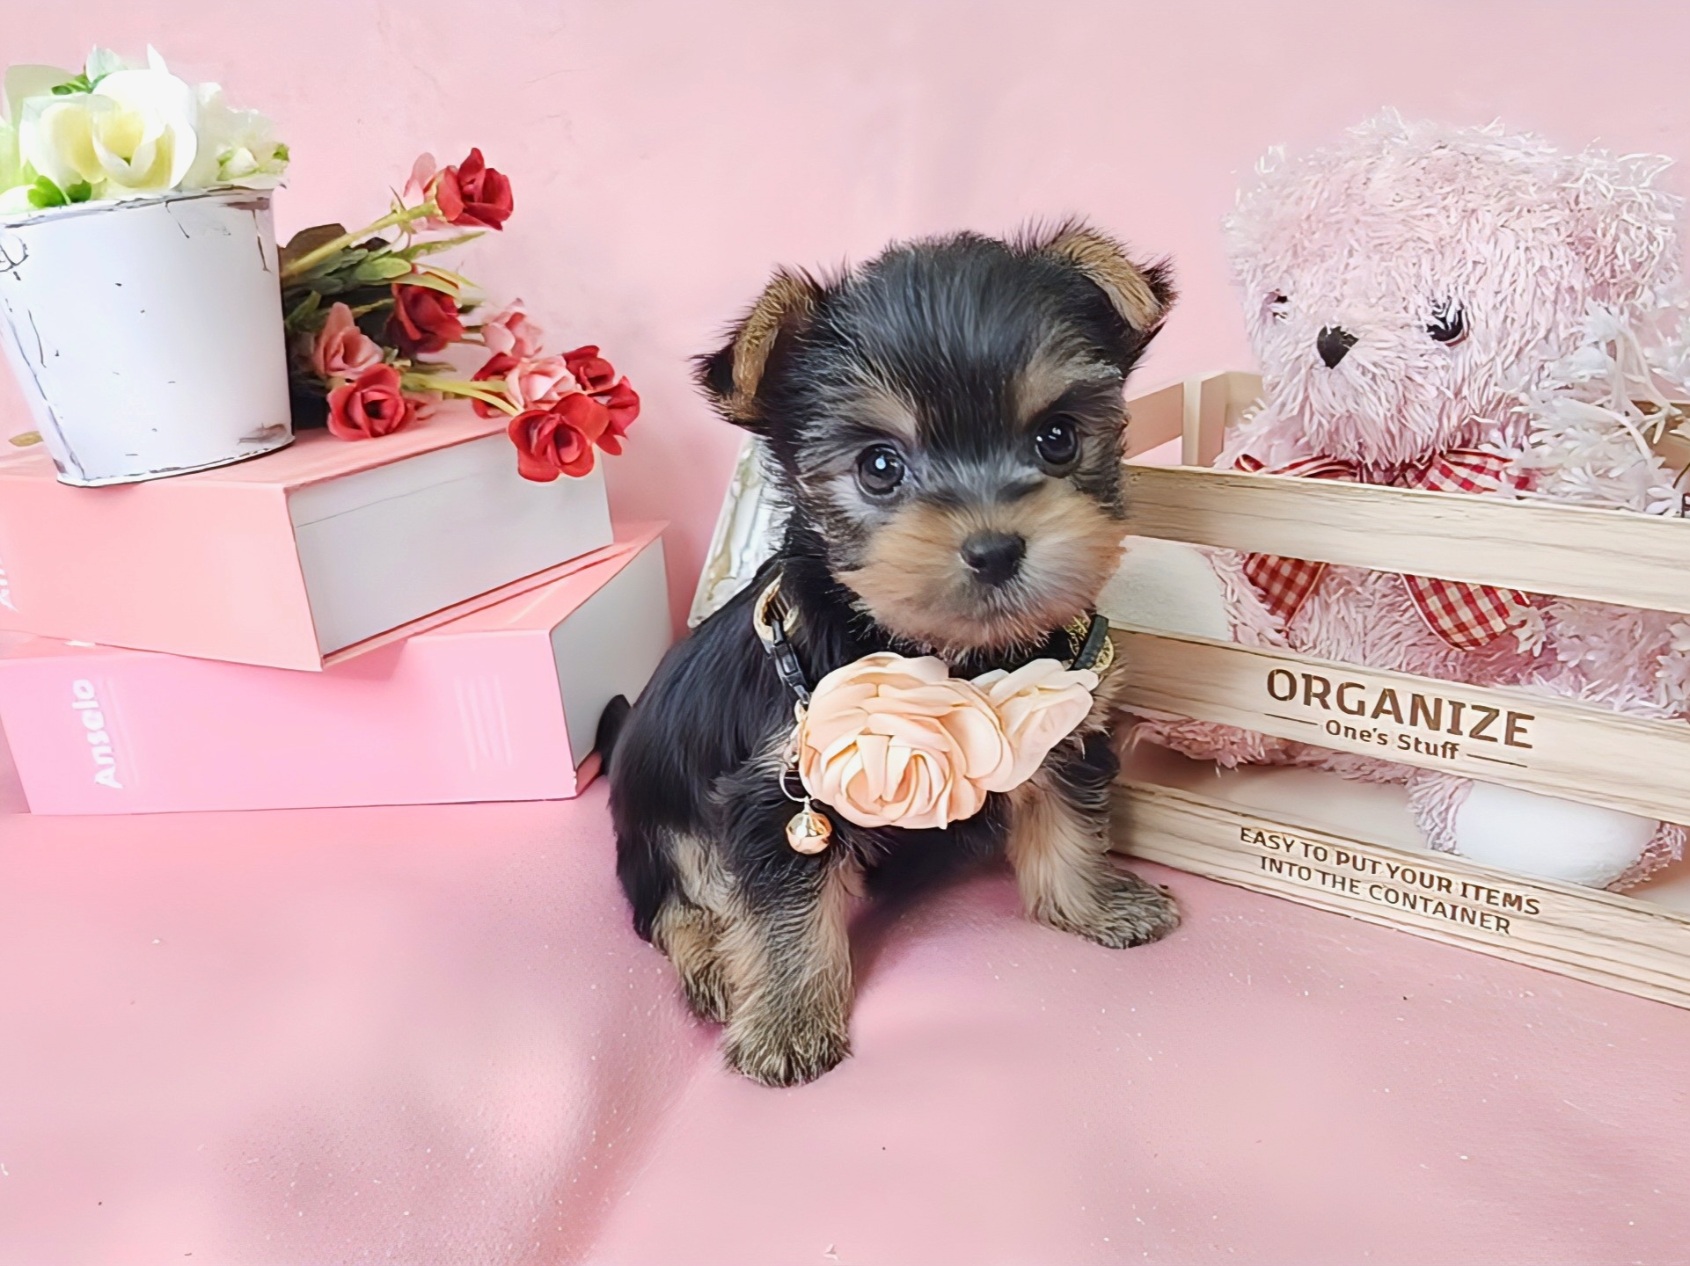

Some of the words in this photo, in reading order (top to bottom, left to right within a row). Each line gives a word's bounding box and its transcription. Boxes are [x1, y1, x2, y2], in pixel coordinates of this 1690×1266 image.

[1266, 668, 1536, 749] ORGANIZE
[1325, 719, 1388, 745] One's
[1397, 733, 1460, 759] Stuff
[1240, 827, 1295, 853] EASY
[1300, 841, 1328, 862] TO
[1336, 850, 1382, 875] PUT
[1386, 862, 1452, 894] YOUR
[1460, 881, 1540, 915] ITEMS
[1260, 856, 1312, 881] INTO
[1314, 869, 1361, 895] THE
[1369, 884, 1510, 935] CONTAINER
